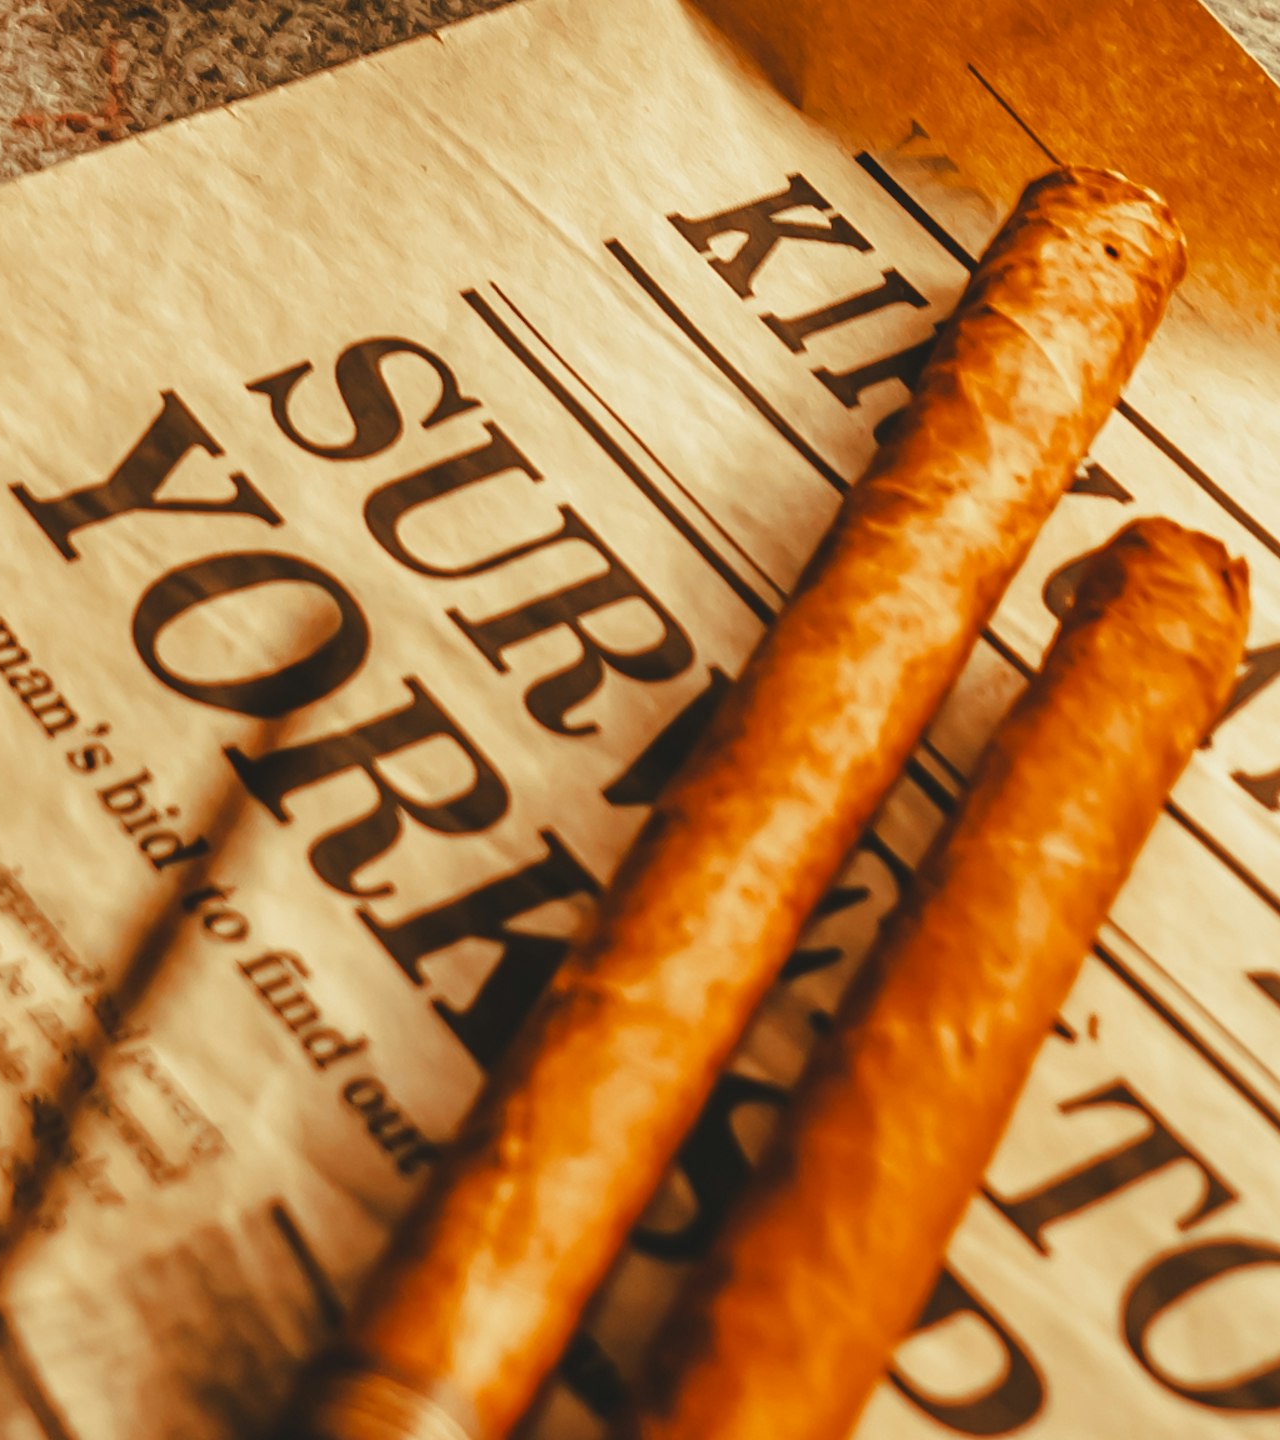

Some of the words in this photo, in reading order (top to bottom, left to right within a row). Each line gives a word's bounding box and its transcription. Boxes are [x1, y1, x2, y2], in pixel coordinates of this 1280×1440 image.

[97, 756, 216, 874] bid
[182, 879, 249, 945] to
[237, 949, 369, 1072] find
